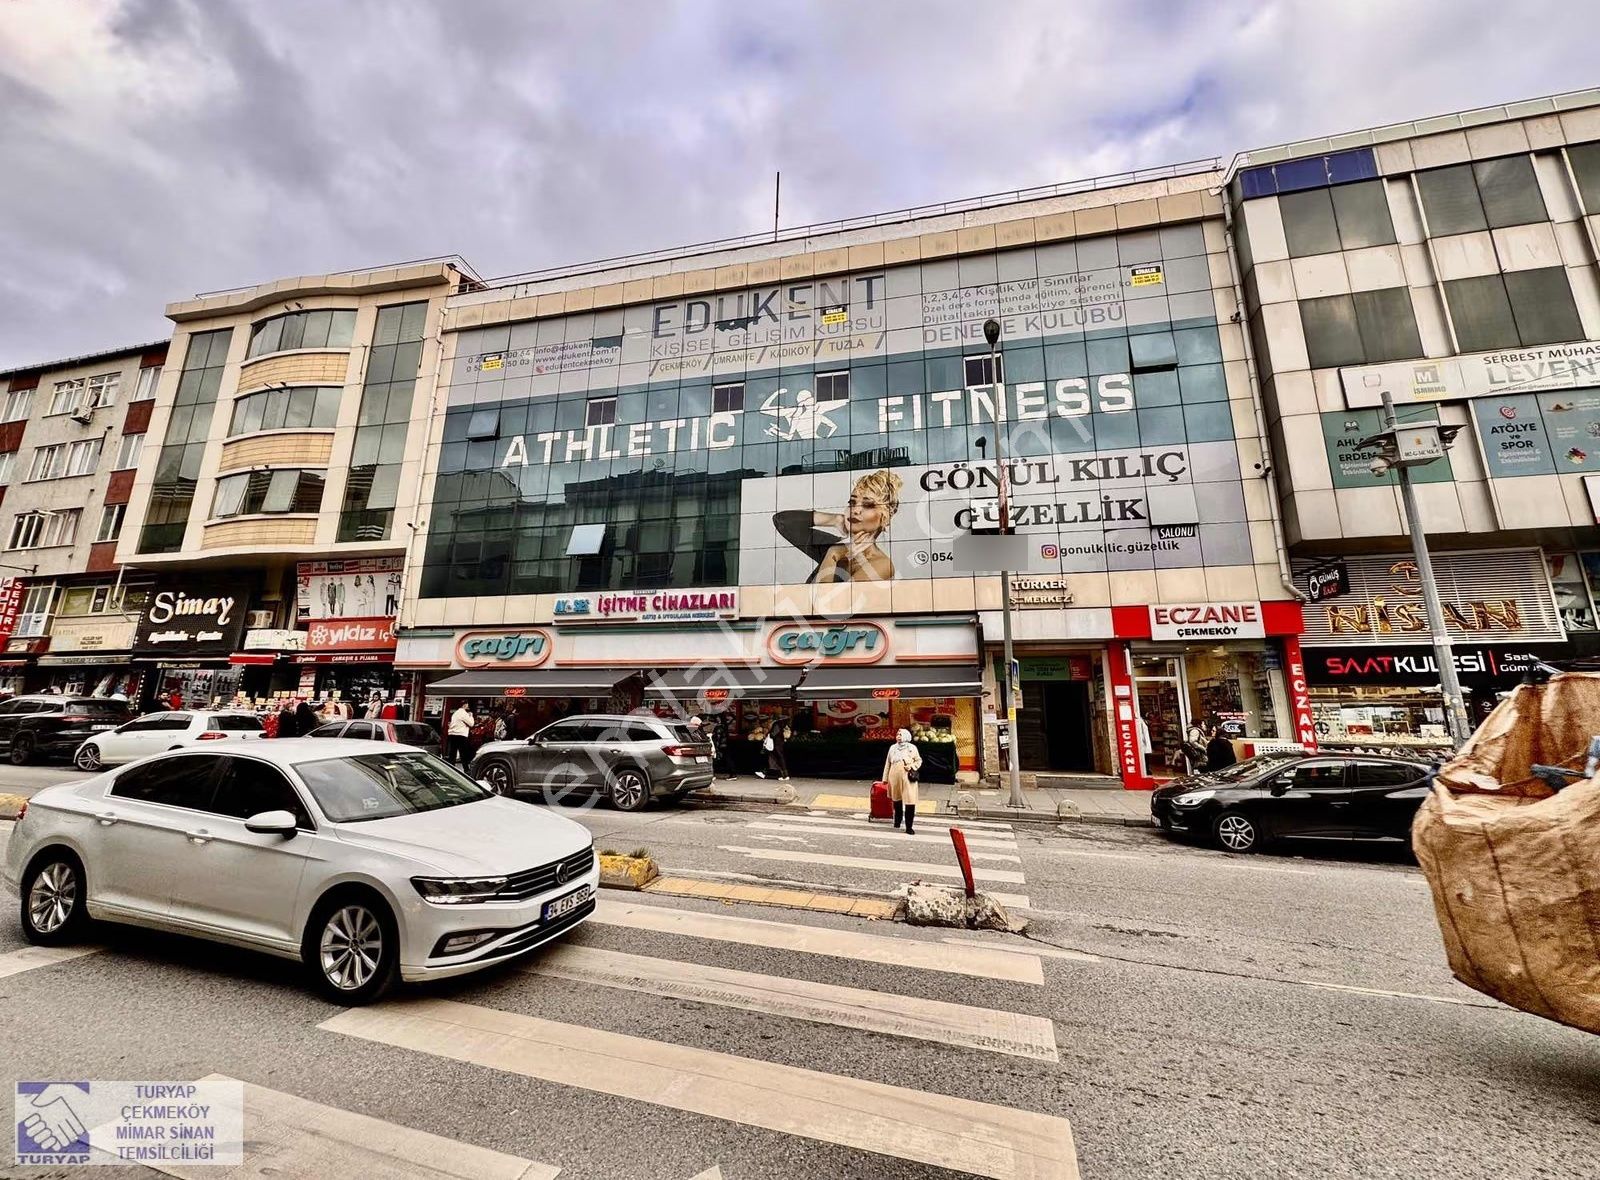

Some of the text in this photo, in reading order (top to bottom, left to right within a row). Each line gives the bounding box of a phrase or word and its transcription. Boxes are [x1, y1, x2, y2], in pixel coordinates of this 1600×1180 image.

[1044, 273, 1093, 287] Sınıflar
[653, 275, 884, 339] EDUKENT
[923, 312, 958, 324] Dijital
[963, 308, 995, 320] takip
[1018, 299, 1065, 313] takviye
[1069, 290, 1120, 305] sistemi
[949, 301, 972, 310] ders
[923, 302, 1124, 344] DENEE KULÜBÜ
[652, 315, 883, 358] KİŞİSEL GELİŞİM KURSU
[659, 358, 702, 373] ÇEKMEKÖY
[829, 338, 865, 352] TUZLA
[1483, 351, 1543, 365] SERBEST
[1486, 356, 1600, 385] LEVEN
[877, 373, 1135, 434] FITNESS
[501, 412, 736, 468] ATHLETIC
[1490, 423, 1537, 435] ATÖLYE
[1501, 440, 1534, 450] SPOR
[919, 451, 1187, 492] GÖNÜL KILIÇ
[953, 494, 1148, 531] GÜZELLİK
[1159, 527, 1194, 539] SALONU
[932, 551, 954, 563] 054
[1060, 541, 1180, 558] gonulkilic.güzellik
[1012, 579, 1067, 591] TÜRKER
[1317, 569, 1340, 585] GÜMÜŞ
[149, 591, 235, 626] Simay
[598, 592, 736, 617] İŞİTME CİHAZLARI
[1024, 593, 1074, 604] MERKEZİ
[1154, 605, 1259, 625] ECZANE
[328, 624, 376, 645] yıldız
[777, 624, 880, 656] çağrı
[1176, 625, 1239, 637] ÇEKMEKÖY
[463, 631, 545, 661] çağrı
[1504, 653, 1530, 661] Saa
[1121, 724, 1136, 774] ECZANE
